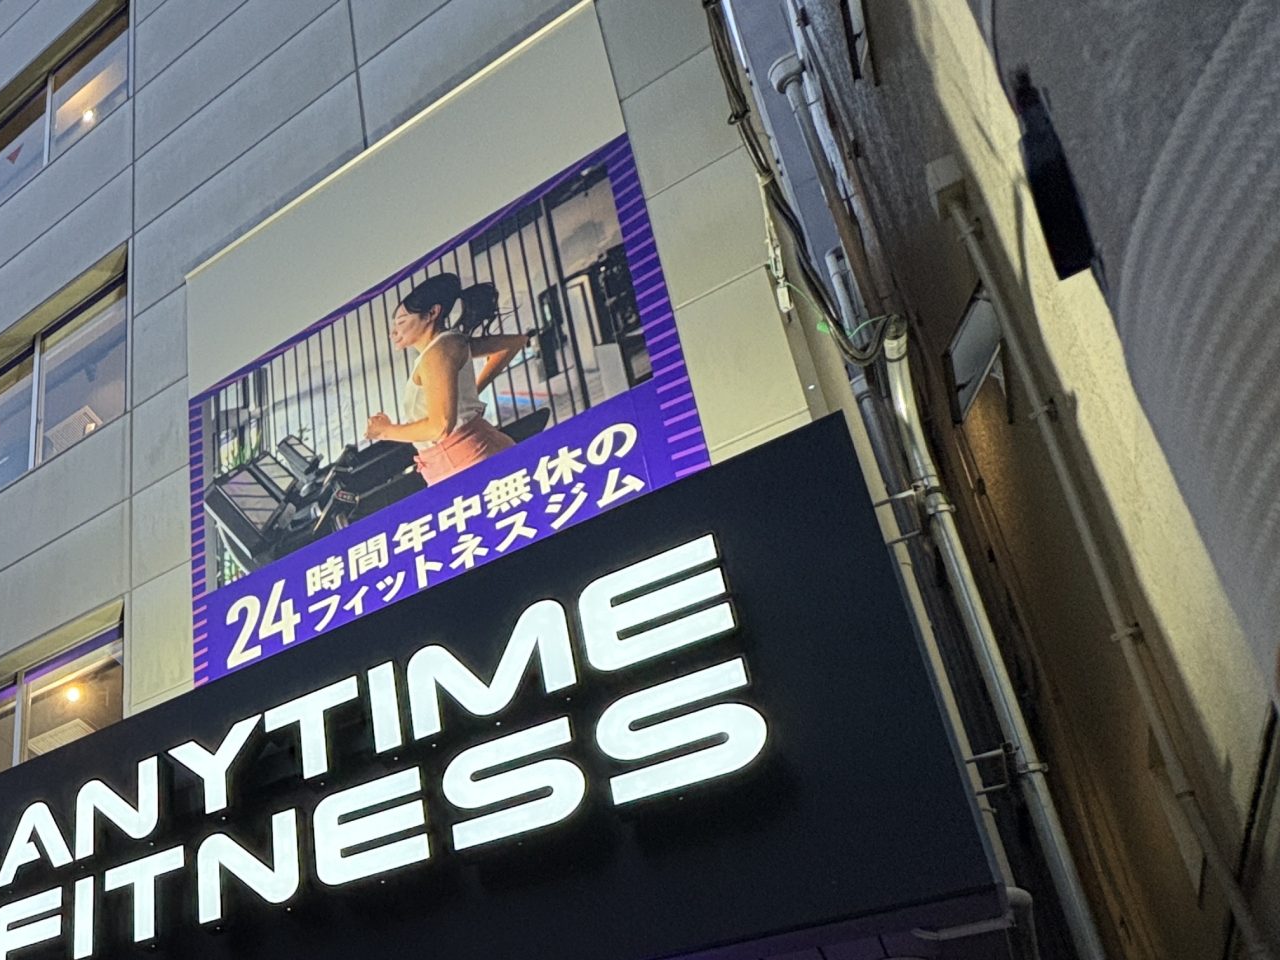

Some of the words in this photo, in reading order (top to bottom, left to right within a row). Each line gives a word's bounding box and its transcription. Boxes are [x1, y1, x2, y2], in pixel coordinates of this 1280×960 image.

[225, 579, 302, 670] 24
[306, 421, 638, 598] 時間年中無休の
[308, 474, 646, 633] フィットネスジム
